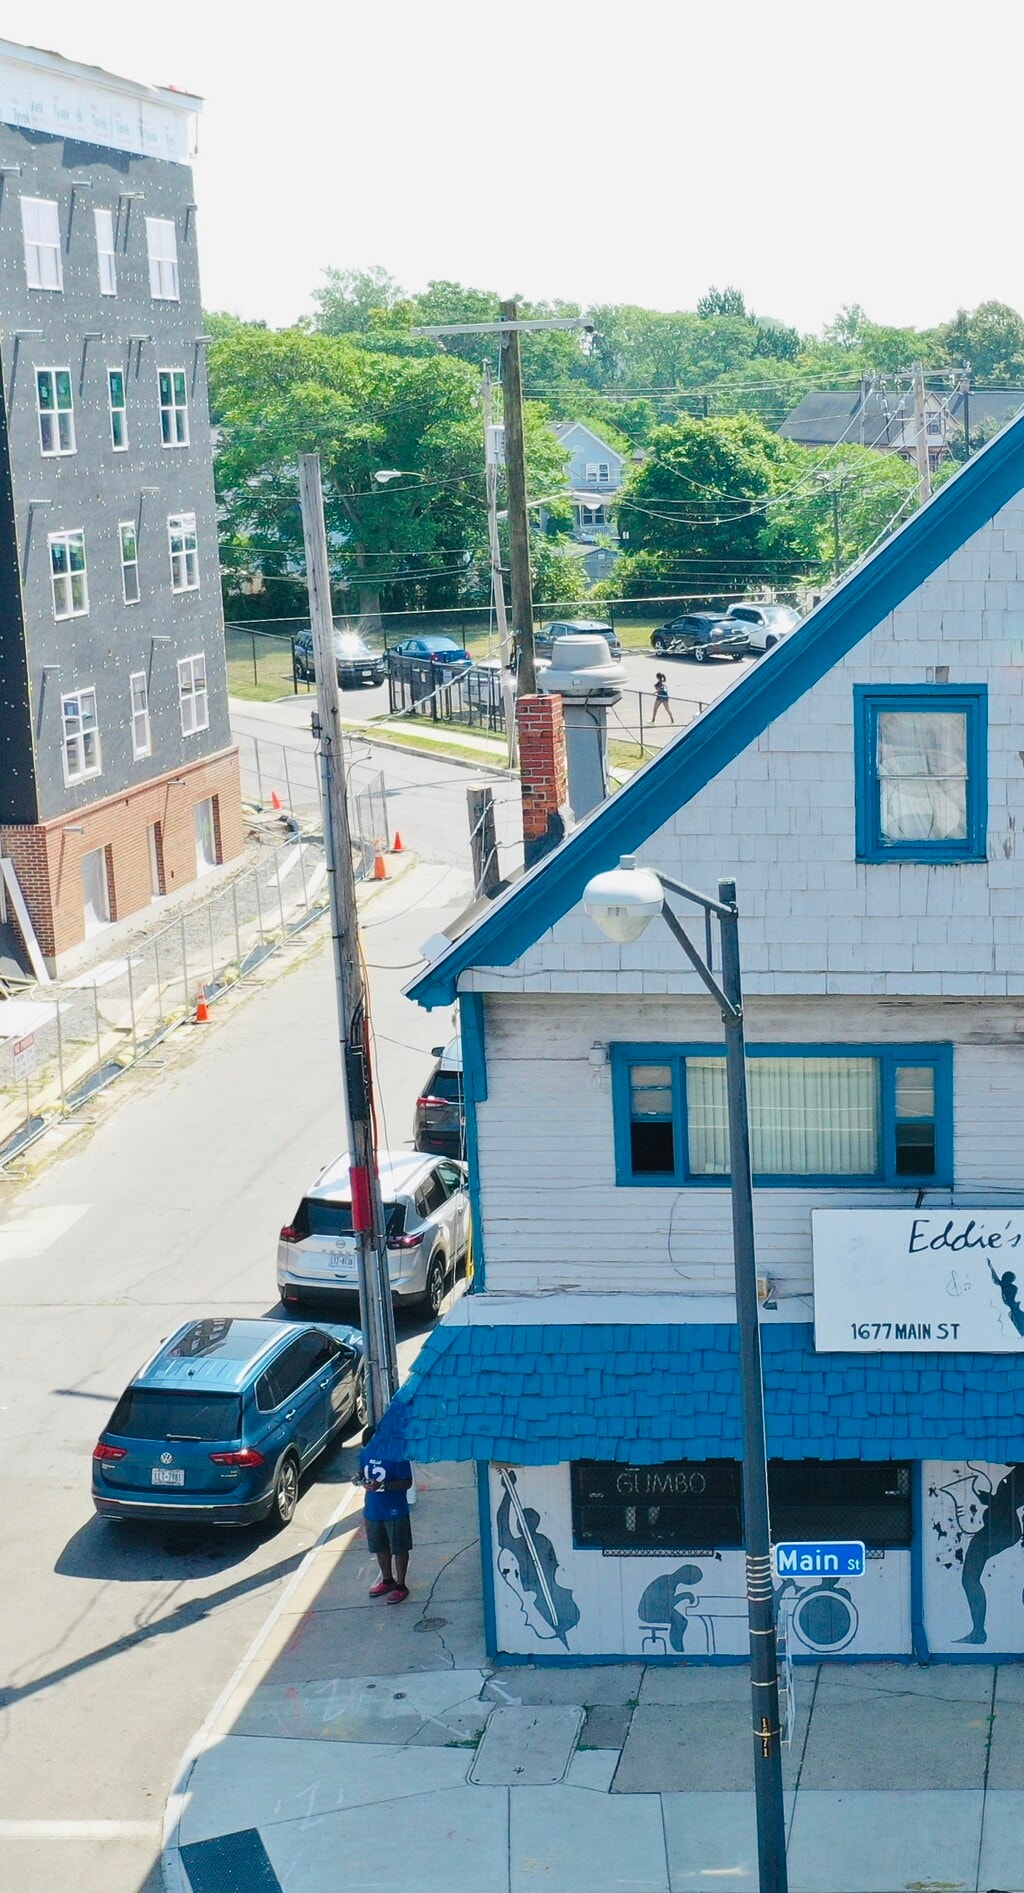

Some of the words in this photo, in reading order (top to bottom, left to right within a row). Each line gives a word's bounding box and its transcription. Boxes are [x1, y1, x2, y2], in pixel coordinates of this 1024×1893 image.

[909, 1219, 1021, 1253] Eddie's
[851, 1323, 892, 1340] 1677
[895, 1323, 931, 1340] MAIN
[936, 1323, 960, 1340] ST
[616, 1472, 706, 1494] GUMBO
[778, 1549, 839, 1571] Main
[847, 1559, 860, 1570] St
